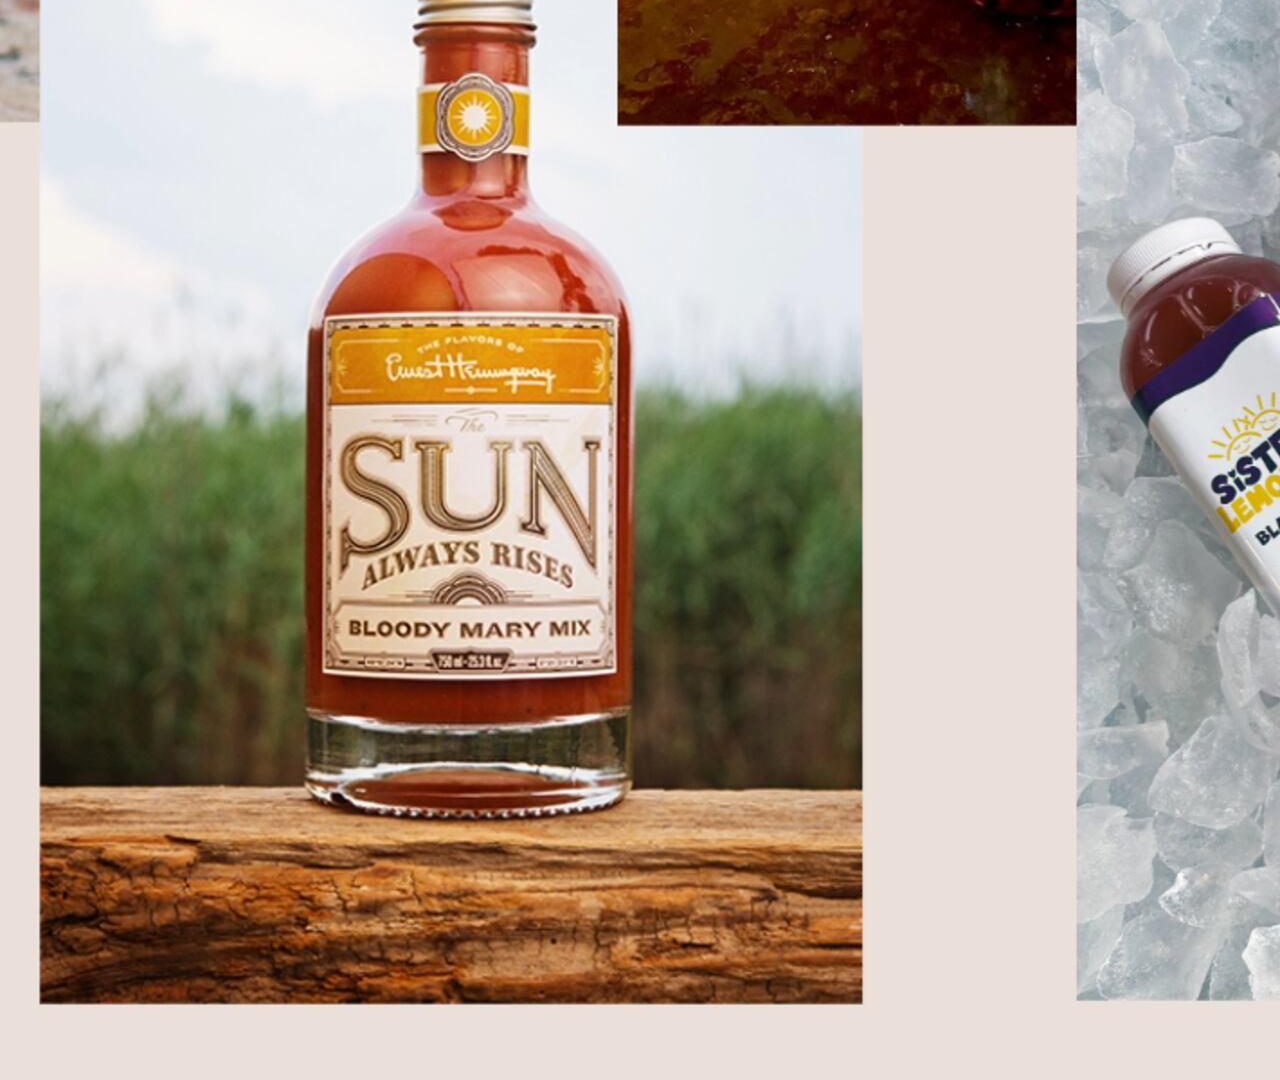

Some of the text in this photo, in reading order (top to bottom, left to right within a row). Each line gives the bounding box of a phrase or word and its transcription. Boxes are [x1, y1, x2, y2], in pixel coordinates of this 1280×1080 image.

[417, 335, 524, 353] THE FLAVORS OF
[339, 436, 600, 579] SUN
[361, 541, 574, 590] ALWAYS RISES
[349, 620, 591, 639] BLOODY MARY MIX
